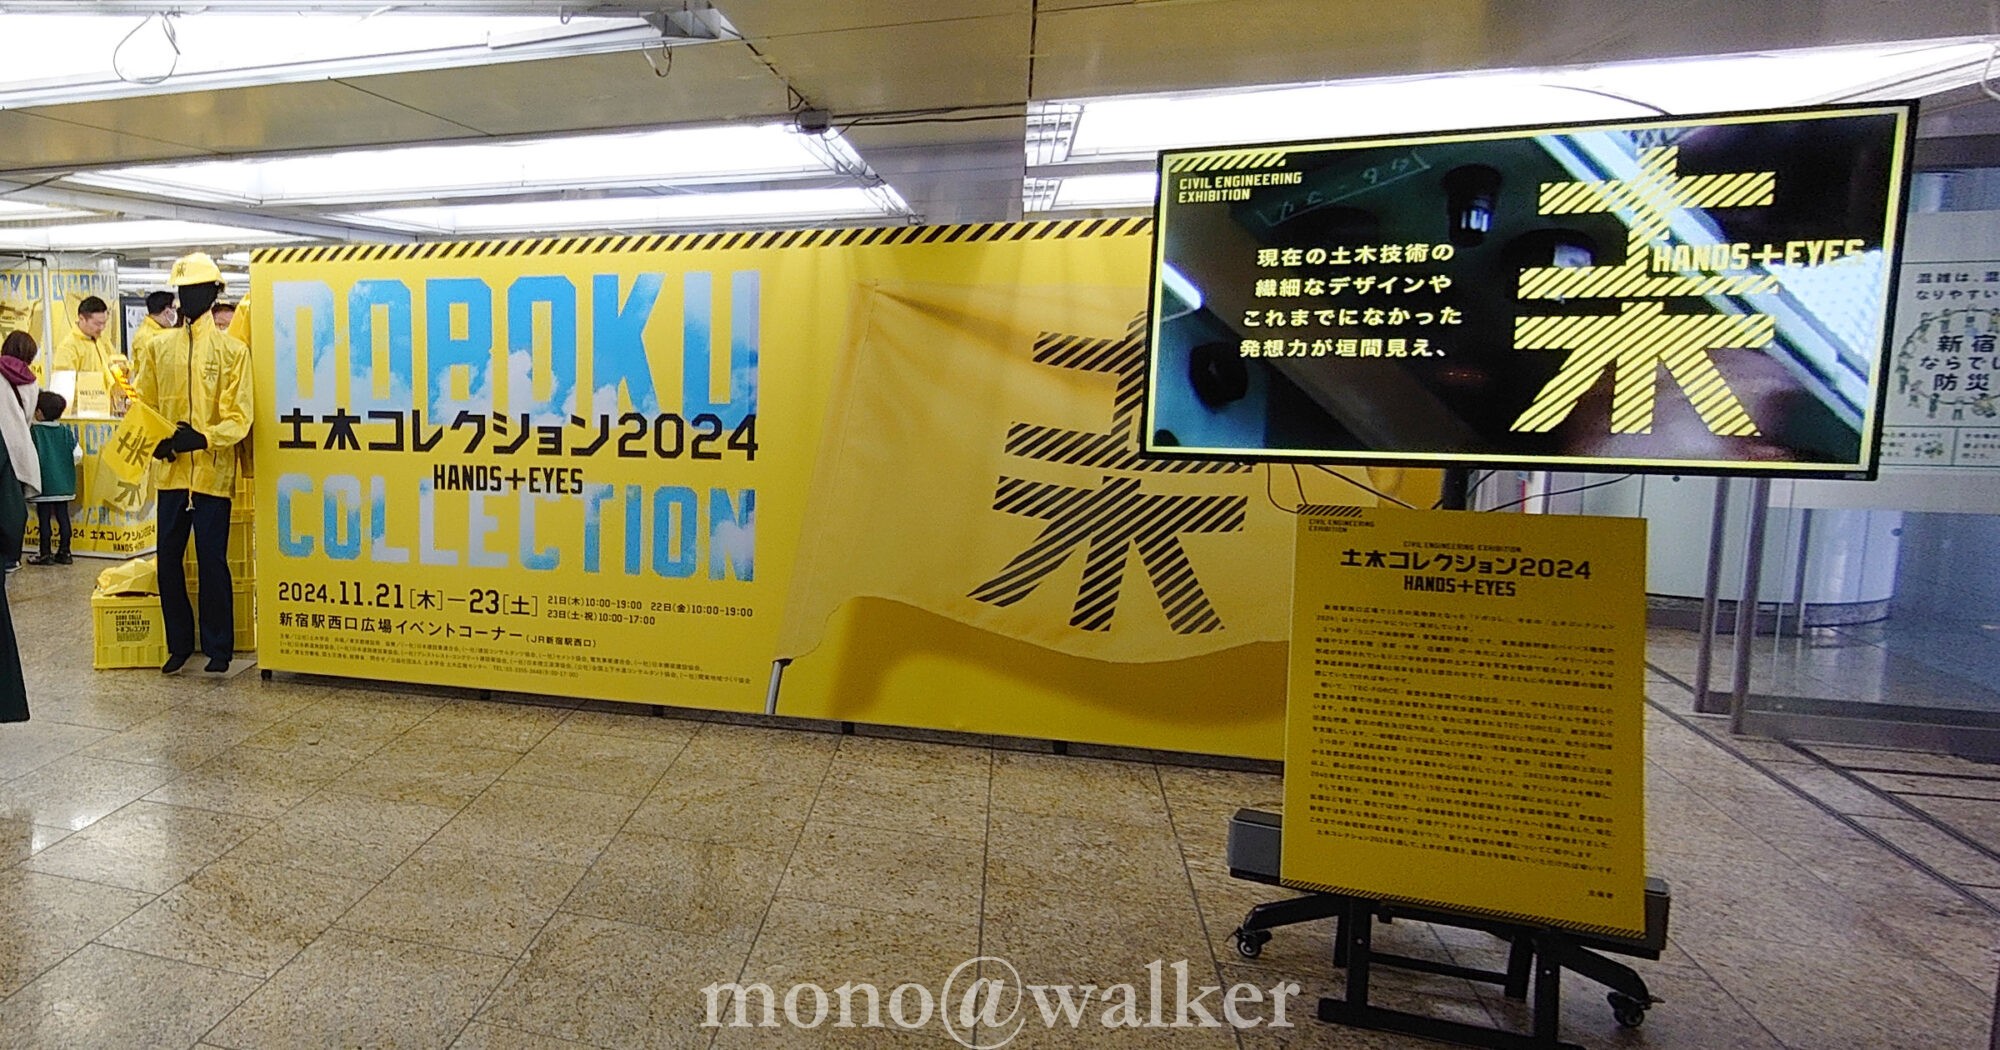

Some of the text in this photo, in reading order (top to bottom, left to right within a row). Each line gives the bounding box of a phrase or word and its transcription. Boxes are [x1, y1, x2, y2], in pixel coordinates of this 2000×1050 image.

[1179, 172, 1302, 190] CIVIL ENGINEERING
[1178, 188, 1250, 203] EXHIBITION
[1256, 243, 1454, 267] 現在の土木技術の
[1652, 239, 1865, 273] HANDS+EYES
[1255, 274, 1452, 298] 繊細なデザインや
[1243, 306, 1463, 327] これまでになかった
[272, 270, 761, 430] DOBOKU
[1239, 338, 1446, 358] 発想力が垣間見え、
[1936, 335, 1998, 353] 新宿
[1934, 373, 1991, 391] 防災
[277, 407, 759, 461] 土木コレクション2024
[433, 464, 583, 495] HANDS+EYES
[276, 472, 755, 582] COLLECTION
[1340, 548, 1592, 580] 土木コレクション2024
[1403, 575, 1517, 597] HANDS+EYES
